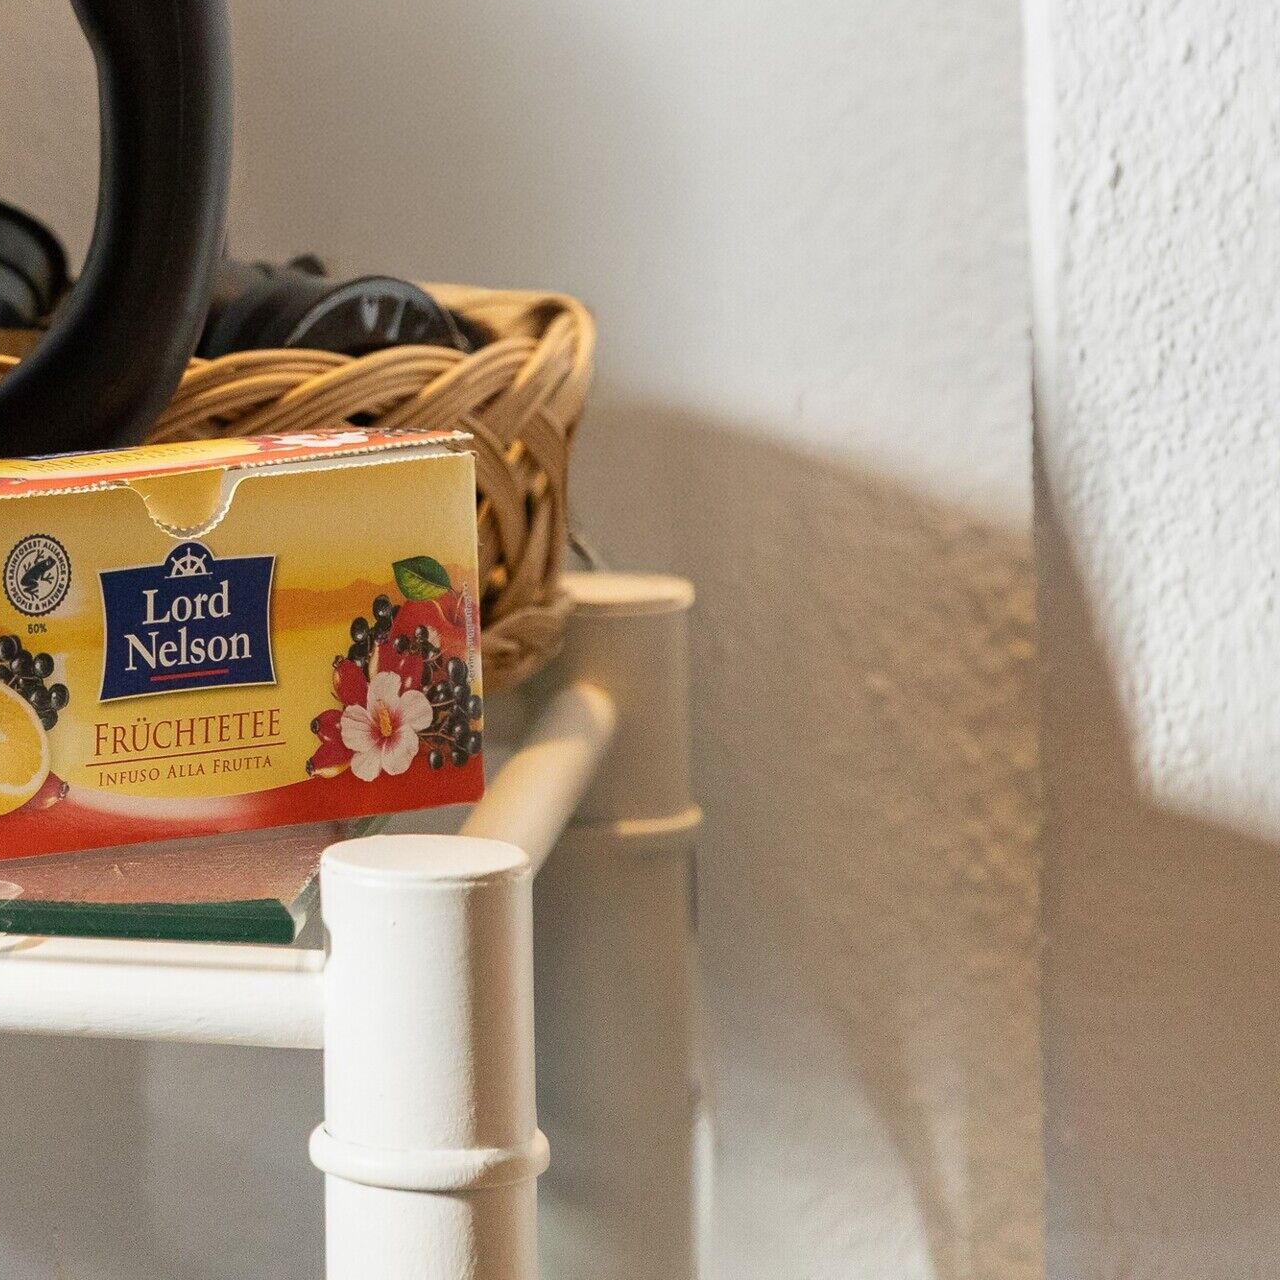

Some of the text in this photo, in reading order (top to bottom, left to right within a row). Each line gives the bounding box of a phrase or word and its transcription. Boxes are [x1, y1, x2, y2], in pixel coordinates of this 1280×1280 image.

[8, 540, 66, 581] RAINFOREST ALLIANCE
[10, 587, 33, 611] PEOPLE
[41, 583, 65, 609] NATURE
[141, 579, 231, 625] Lord
[124, 626, 252, 671] Nelson
[94, 708, 281, 757] FRÜCHTETEE
[98, 755, 273, 787] INFUSO ALLA FRUTTA
